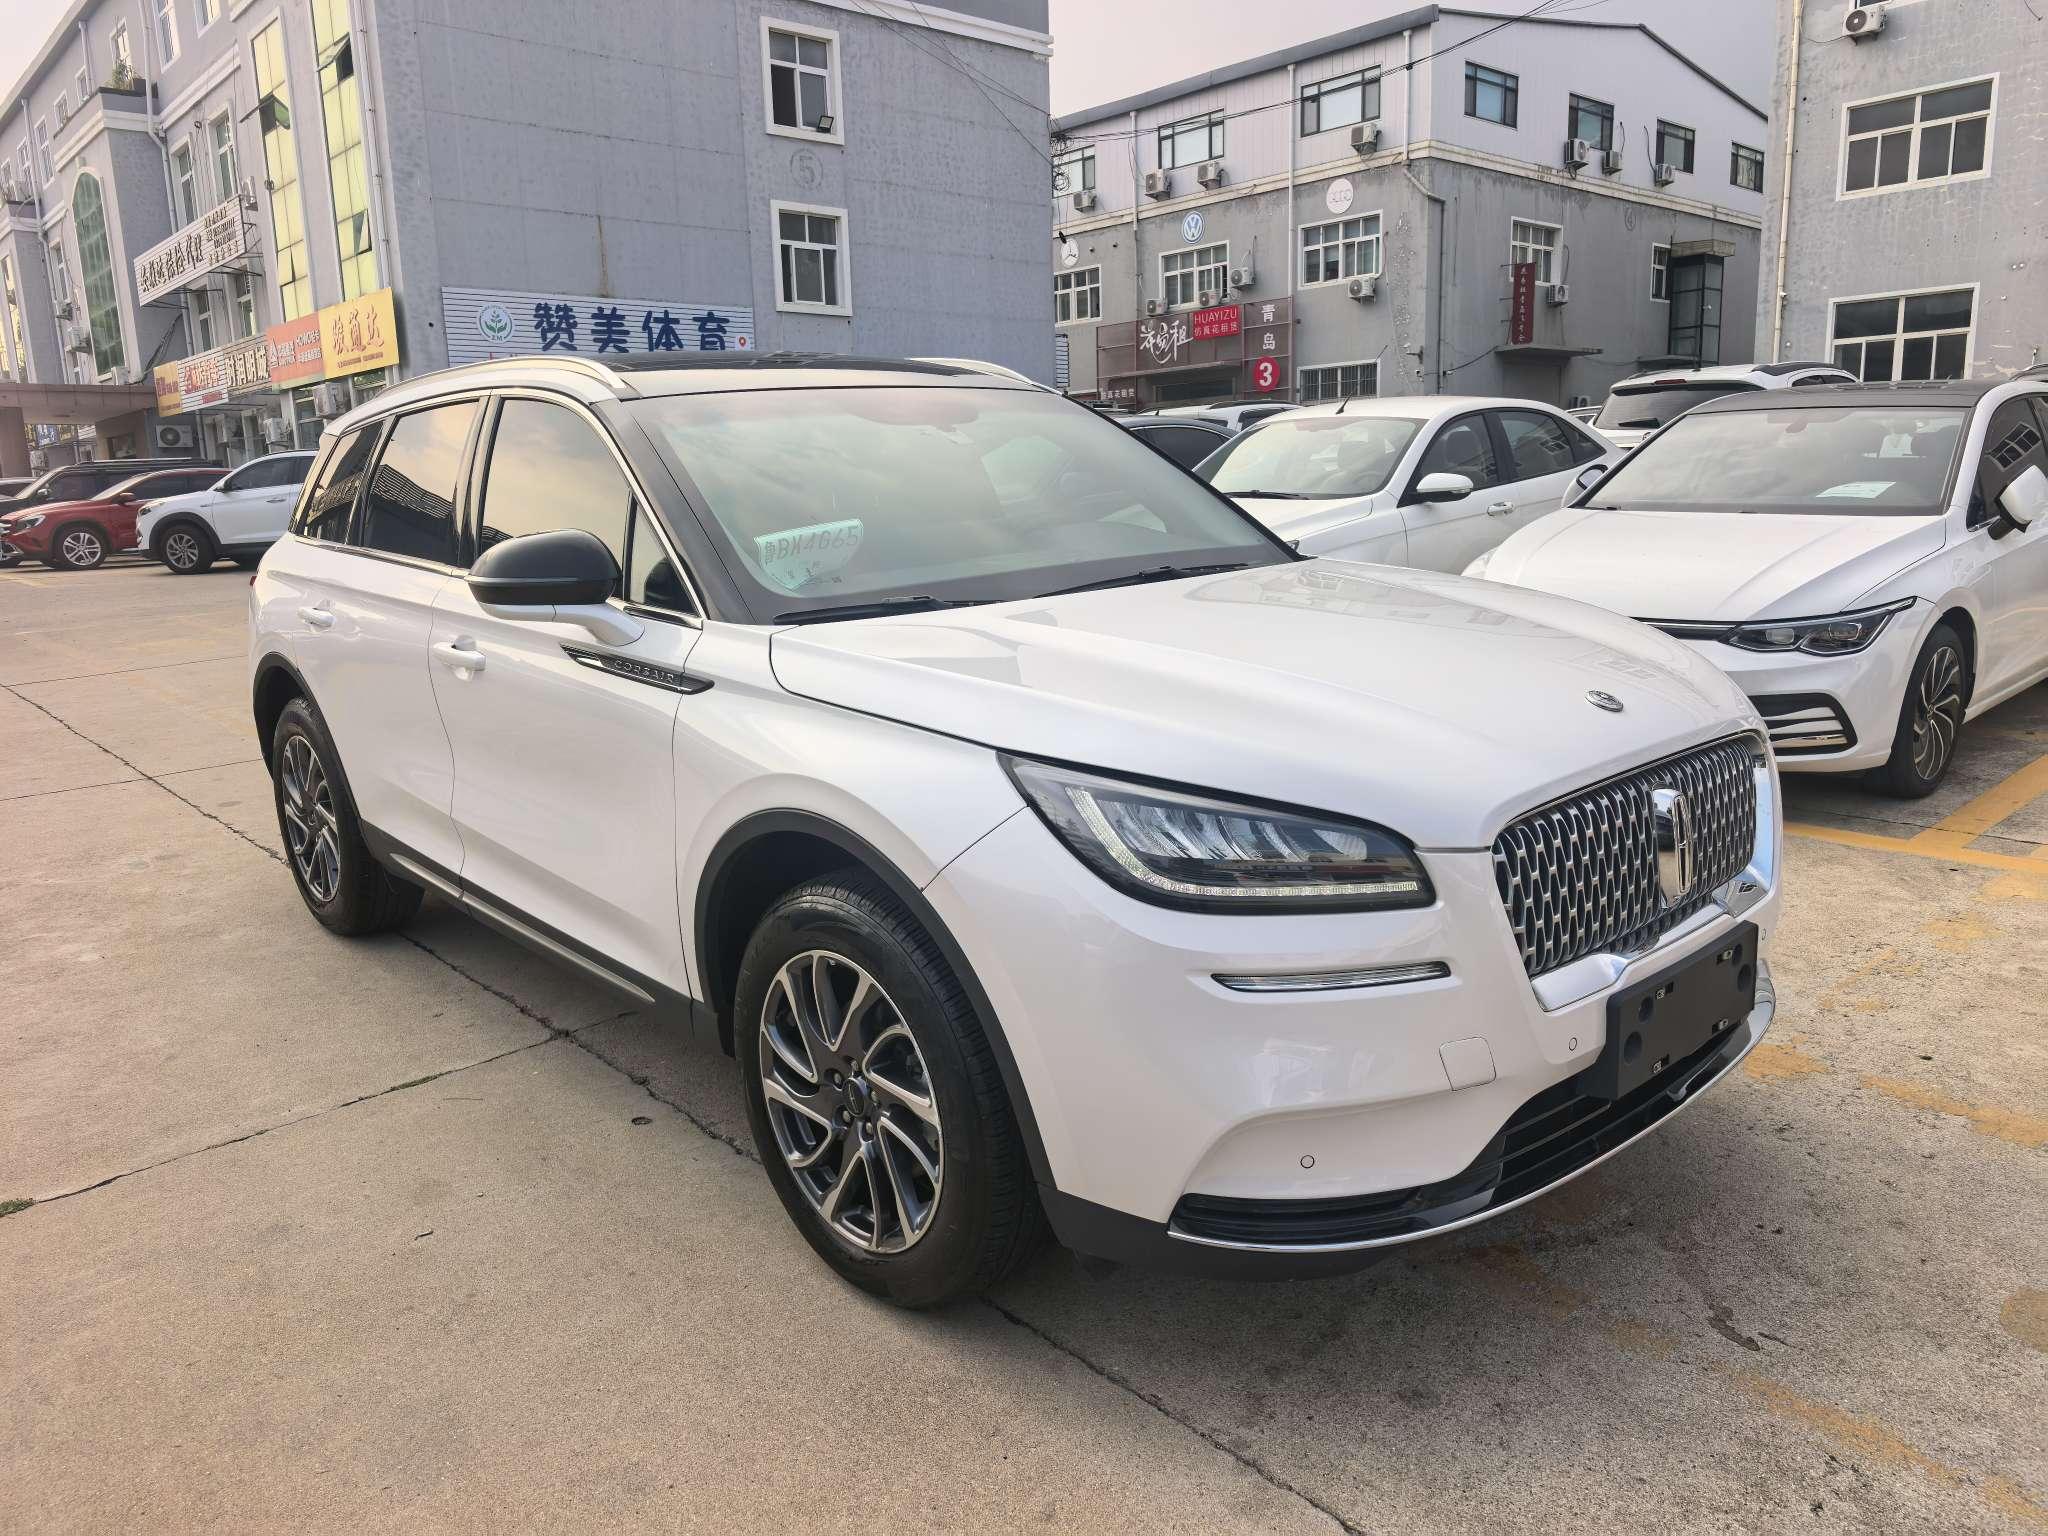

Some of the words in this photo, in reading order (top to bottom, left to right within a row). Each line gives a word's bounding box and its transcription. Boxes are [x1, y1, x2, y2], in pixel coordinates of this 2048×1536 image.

[533, 302, 730, 353] 赞美体育
[1194, 308, 1238, 324] HUAYIZU
